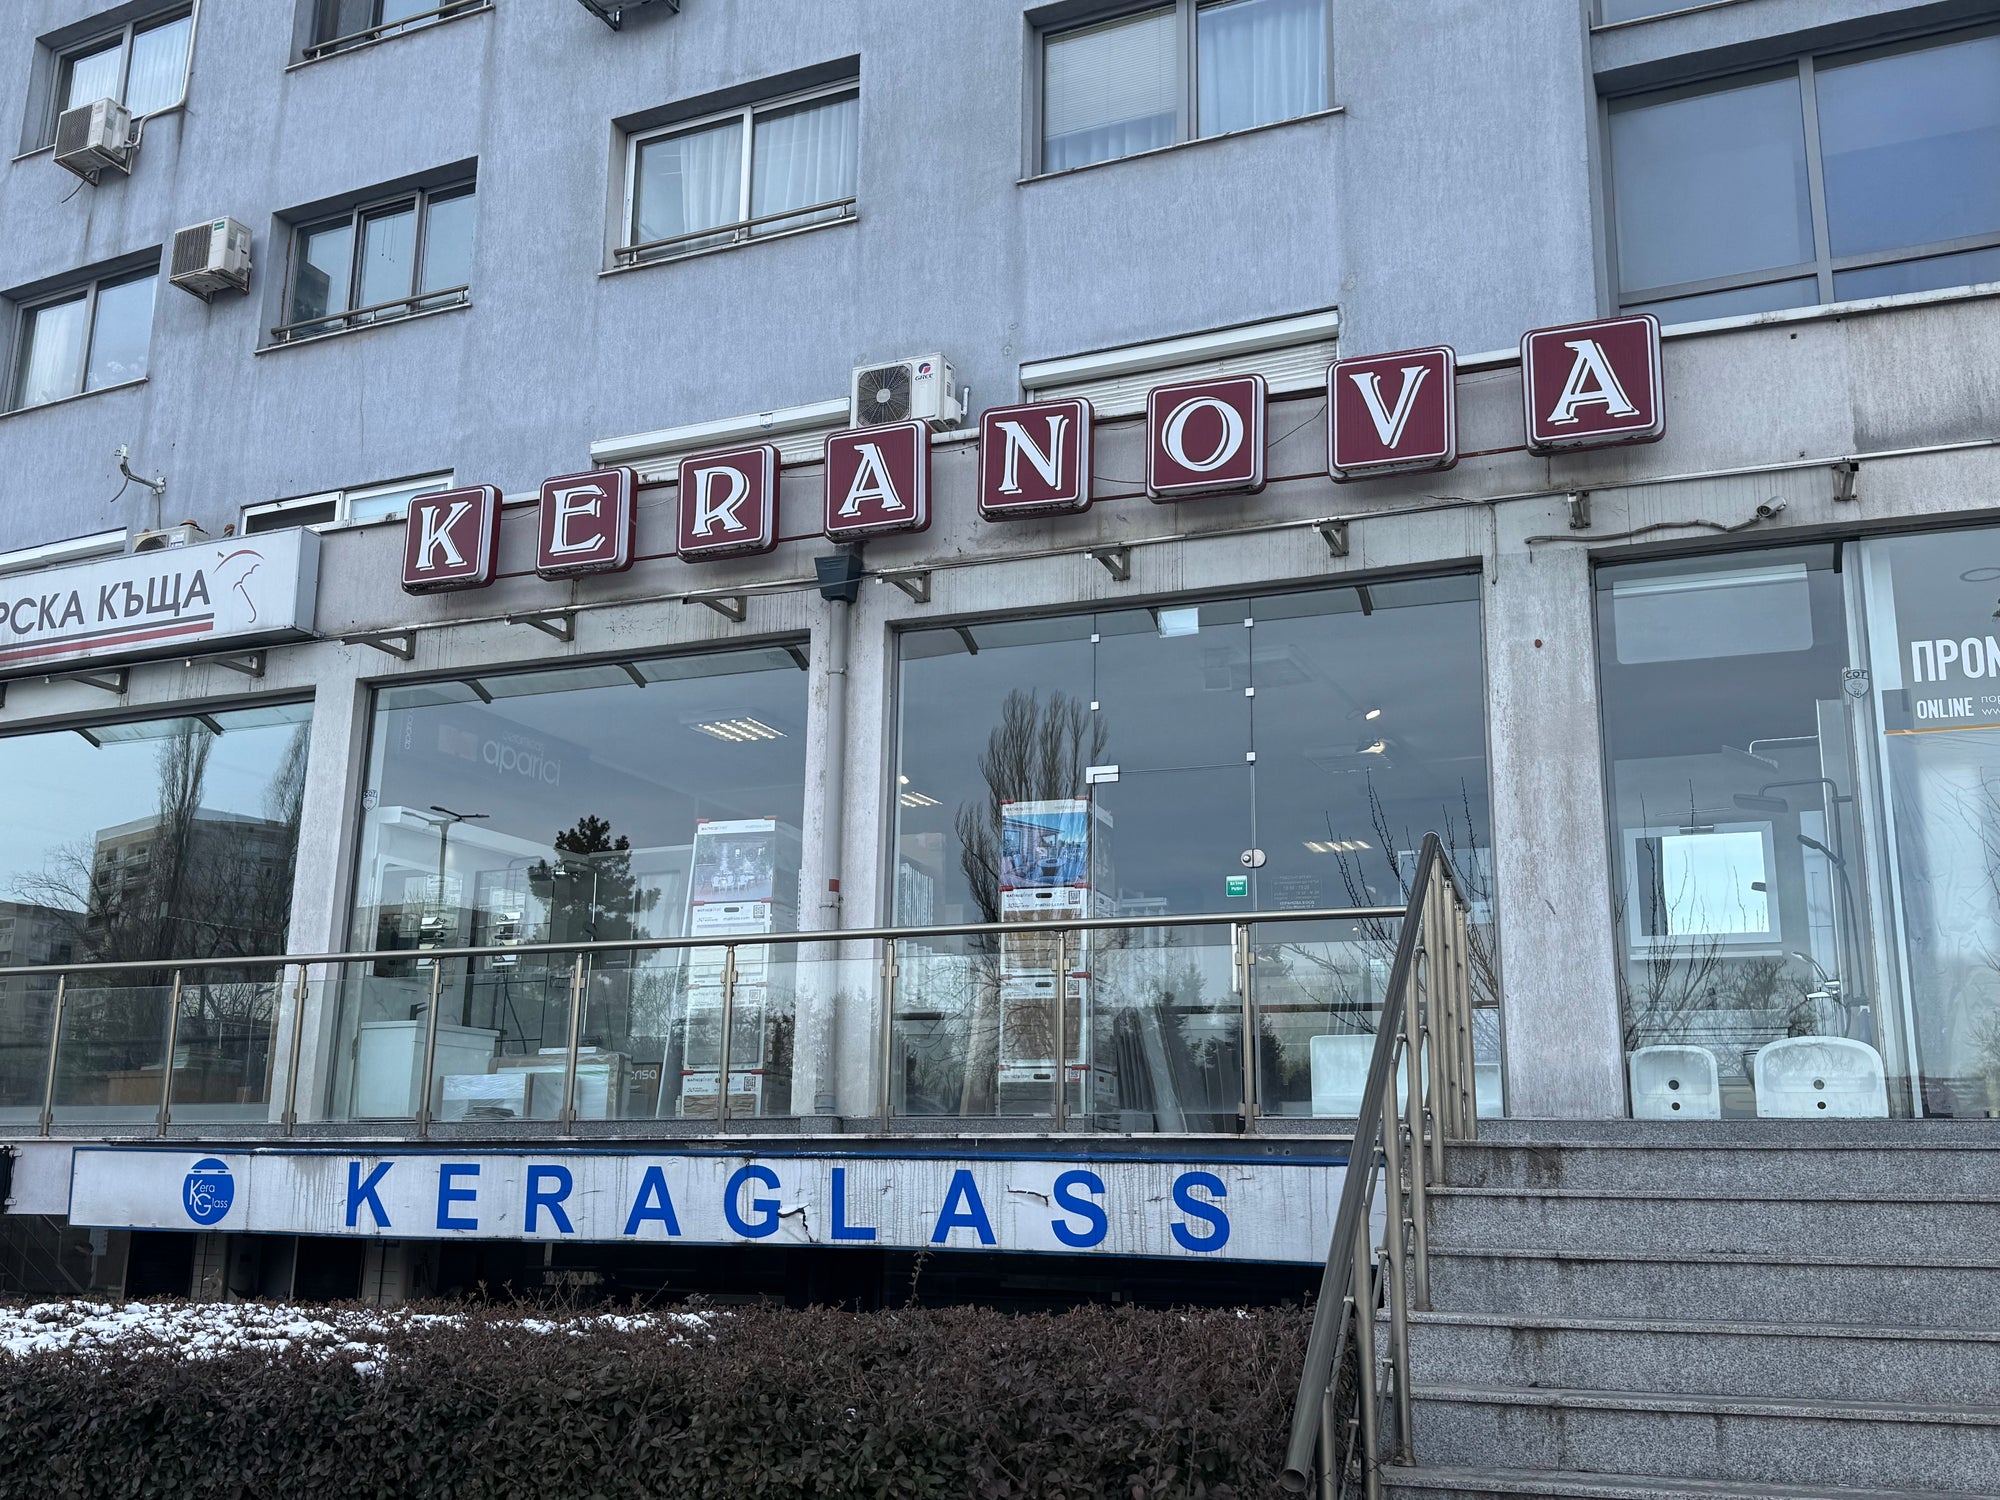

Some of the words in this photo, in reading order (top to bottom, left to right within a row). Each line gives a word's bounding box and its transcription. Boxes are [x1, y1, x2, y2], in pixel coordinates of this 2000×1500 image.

[415, 338, 1641, 571] KERANOVA
[97, 569, 211, 622] КЪЩА
[1916, 697, 1974, 719] ONLINE
[483, 740, 561, 787] aparici
[189, 1179, 216, 1206] Kera
[193, 1193, 228, 1217] Glass
[347, 1160, 1230, 1252] KERAGLASS
